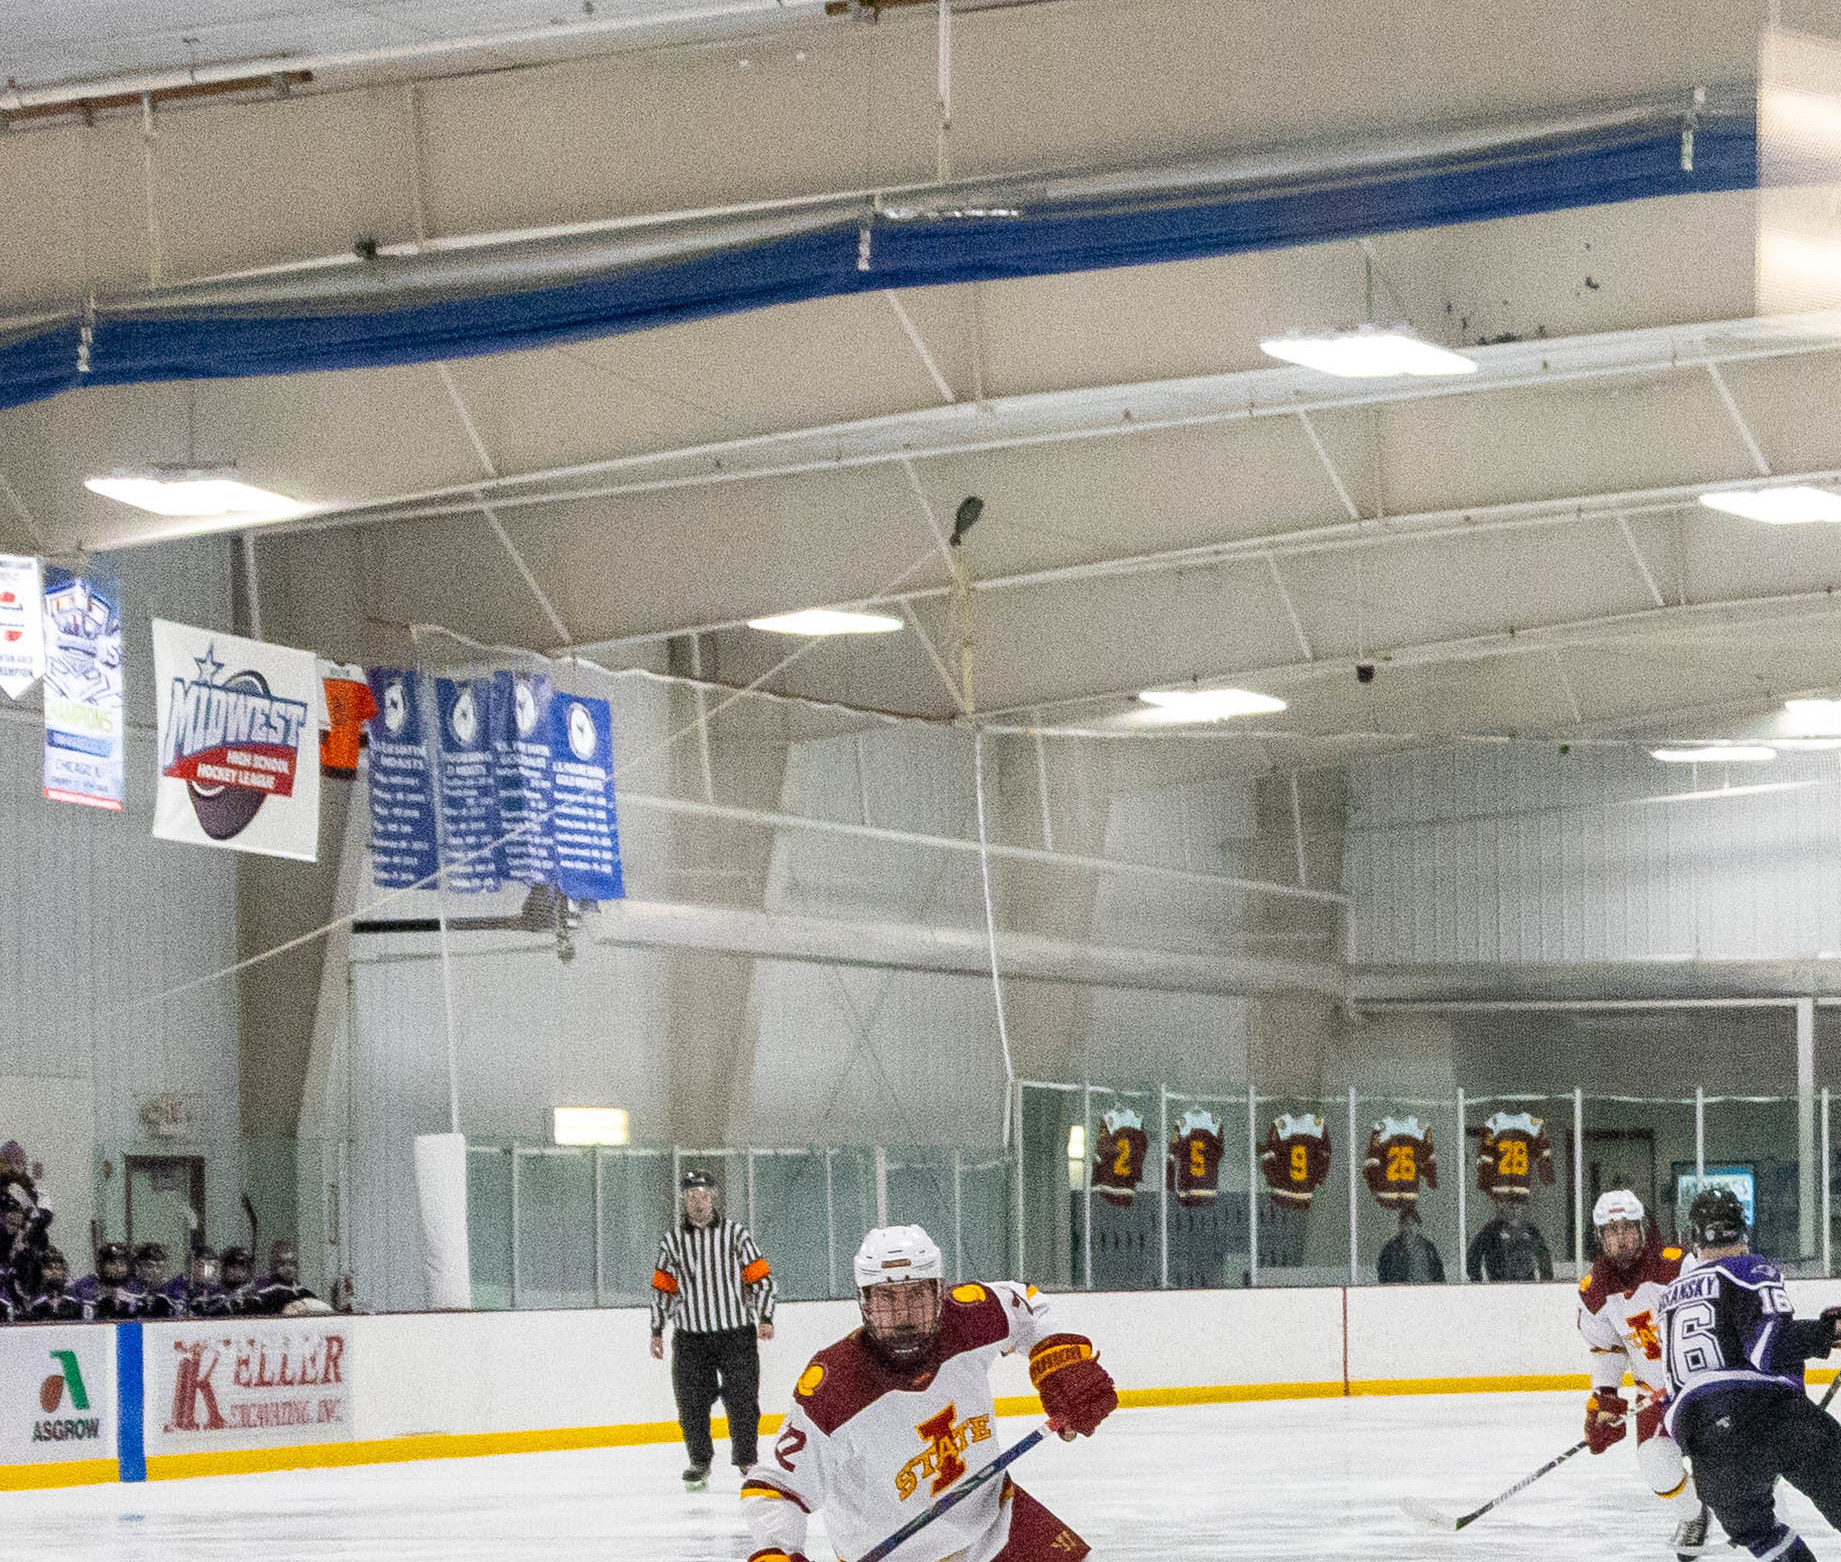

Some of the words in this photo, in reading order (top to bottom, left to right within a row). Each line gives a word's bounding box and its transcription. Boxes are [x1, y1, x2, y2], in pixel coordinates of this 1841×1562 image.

[162, 676, 308, 769] MIDWEST
[197, 762, 237, 783] HOCKEY
[238, 770, 275, 789] LEAGUE
[253, 754, 290, 774] SCHOOL
[1113, 1138, 1131, 1177] 2
[1190, 1140, 1205, 1177] 5
[1290, 1145, 1308, 1181] 9
[1498, 1141, 1529, 1176] 28
[163, 1333, 346, 1434] KELLER
[32, 1417, 99, 1443] ASGROW
[894, 1412, 993, 1502] STATE
